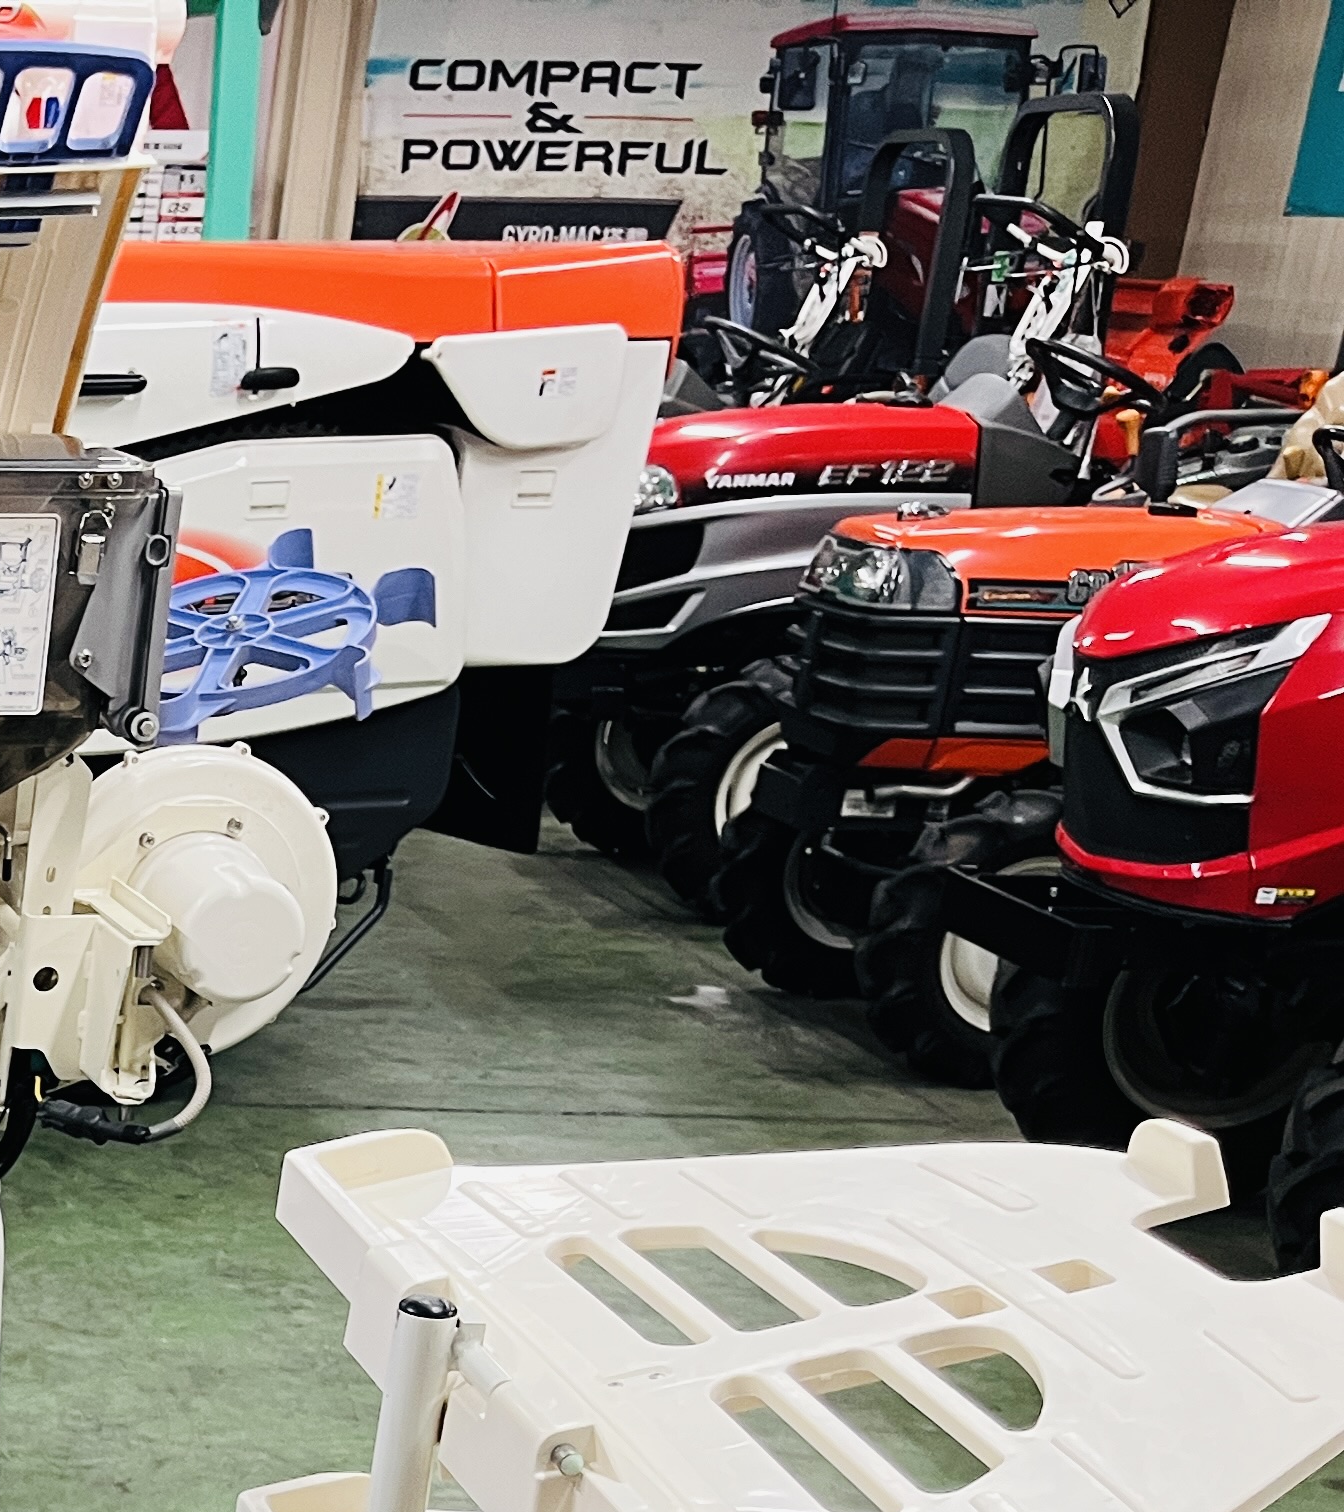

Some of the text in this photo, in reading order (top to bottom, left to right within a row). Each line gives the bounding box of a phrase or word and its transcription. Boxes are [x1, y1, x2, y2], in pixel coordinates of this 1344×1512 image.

[409, 58, 703, 100] COMPACT
[525, 101, 584, 134] &
[401, 138, 729, 177] POWERFUL
[705, 466, 796, 489] YANMAR
